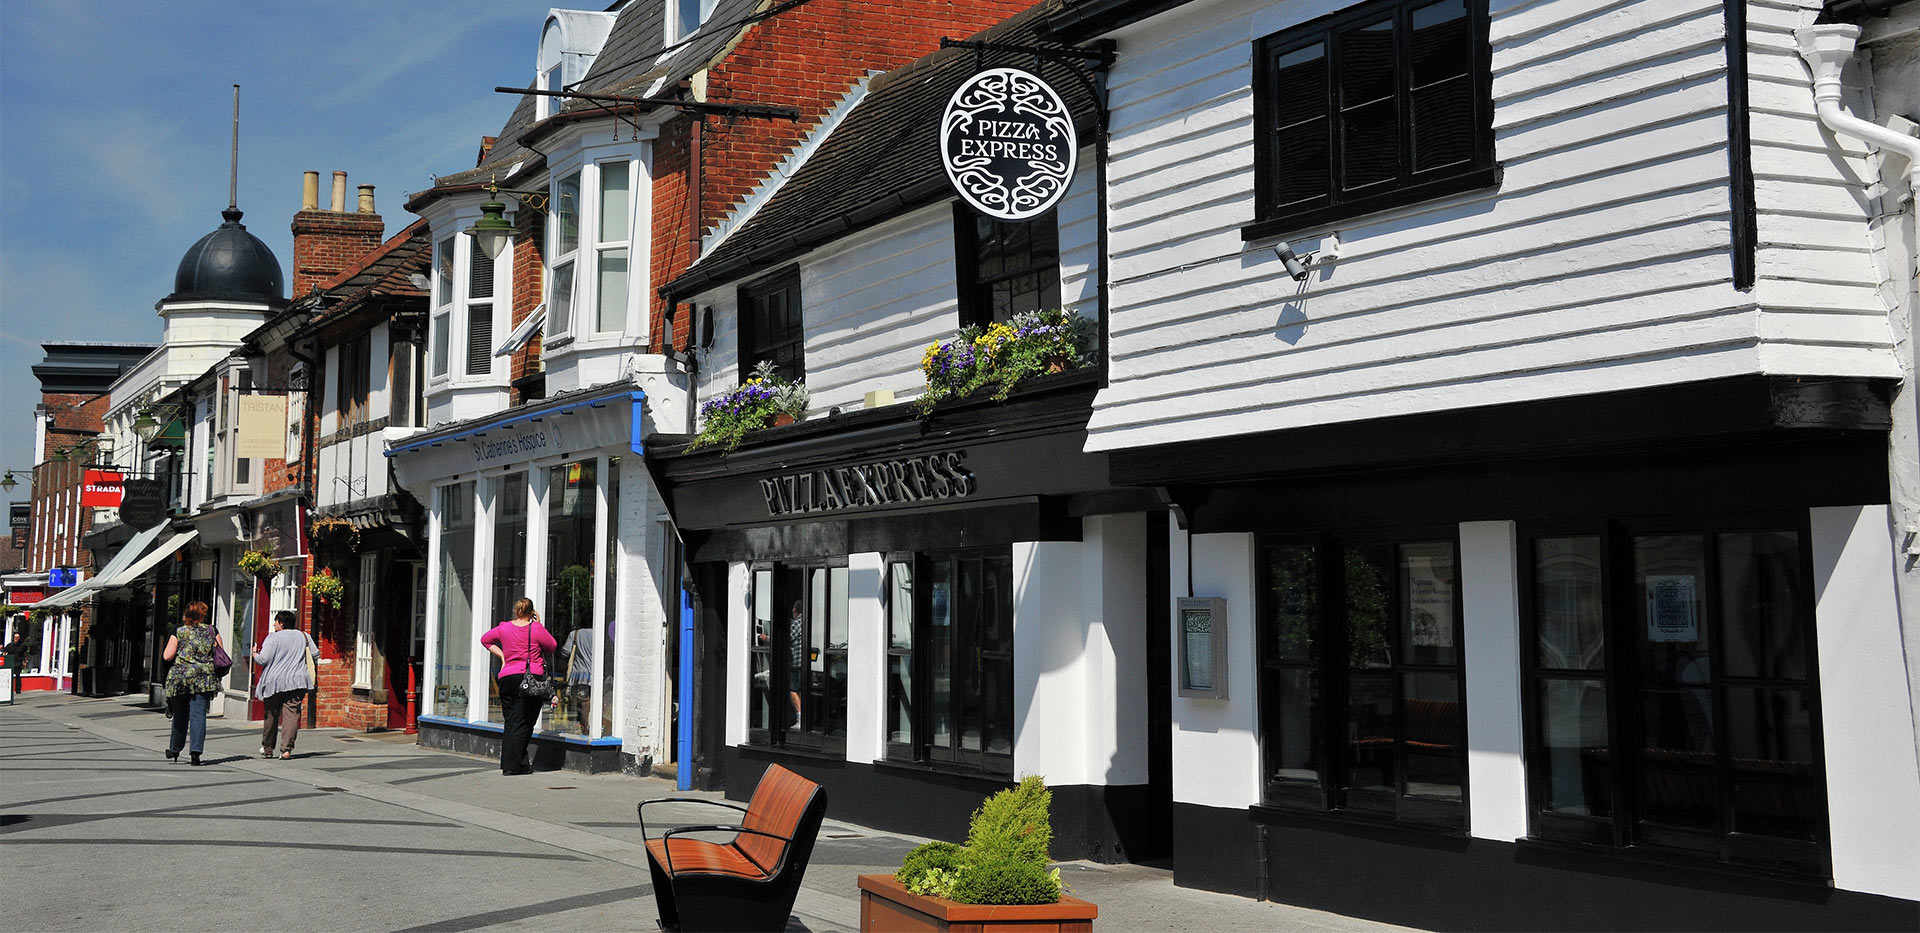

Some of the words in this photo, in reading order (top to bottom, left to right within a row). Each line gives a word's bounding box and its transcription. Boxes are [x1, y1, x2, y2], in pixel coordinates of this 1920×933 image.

[978, 119, 1041, 140] PIZZA
[961, 139, 1058, 161] EXPRESS
[519, 432, 546, 456] Hospice
[85, 485, 121, 493] STRADA
[759, 450, 974, 516] PIZZAEXPRESS
